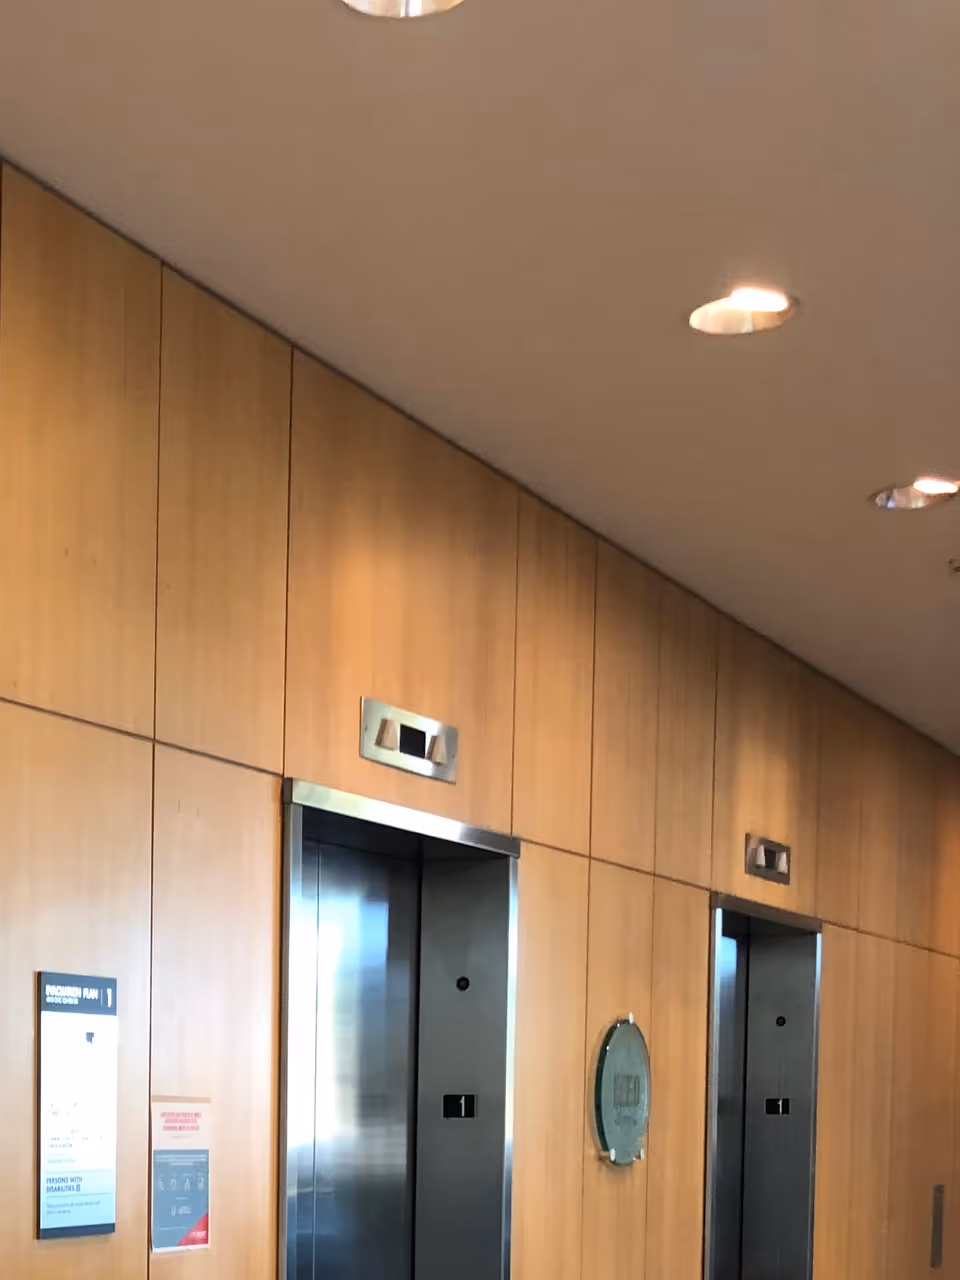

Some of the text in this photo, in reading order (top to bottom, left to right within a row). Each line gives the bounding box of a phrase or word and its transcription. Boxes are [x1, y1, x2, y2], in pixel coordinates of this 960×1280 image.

[83, 987, 98, 1000] PLAN
[106, 988, 112, 1008] 1
[459, 1095, 465, 1117] 1
[777, 1099, 782, 1113] 1
[46, 1176, 83, 1185] PERSONS WITH
[46, 1184, 75, 1194] DISABILITIES
